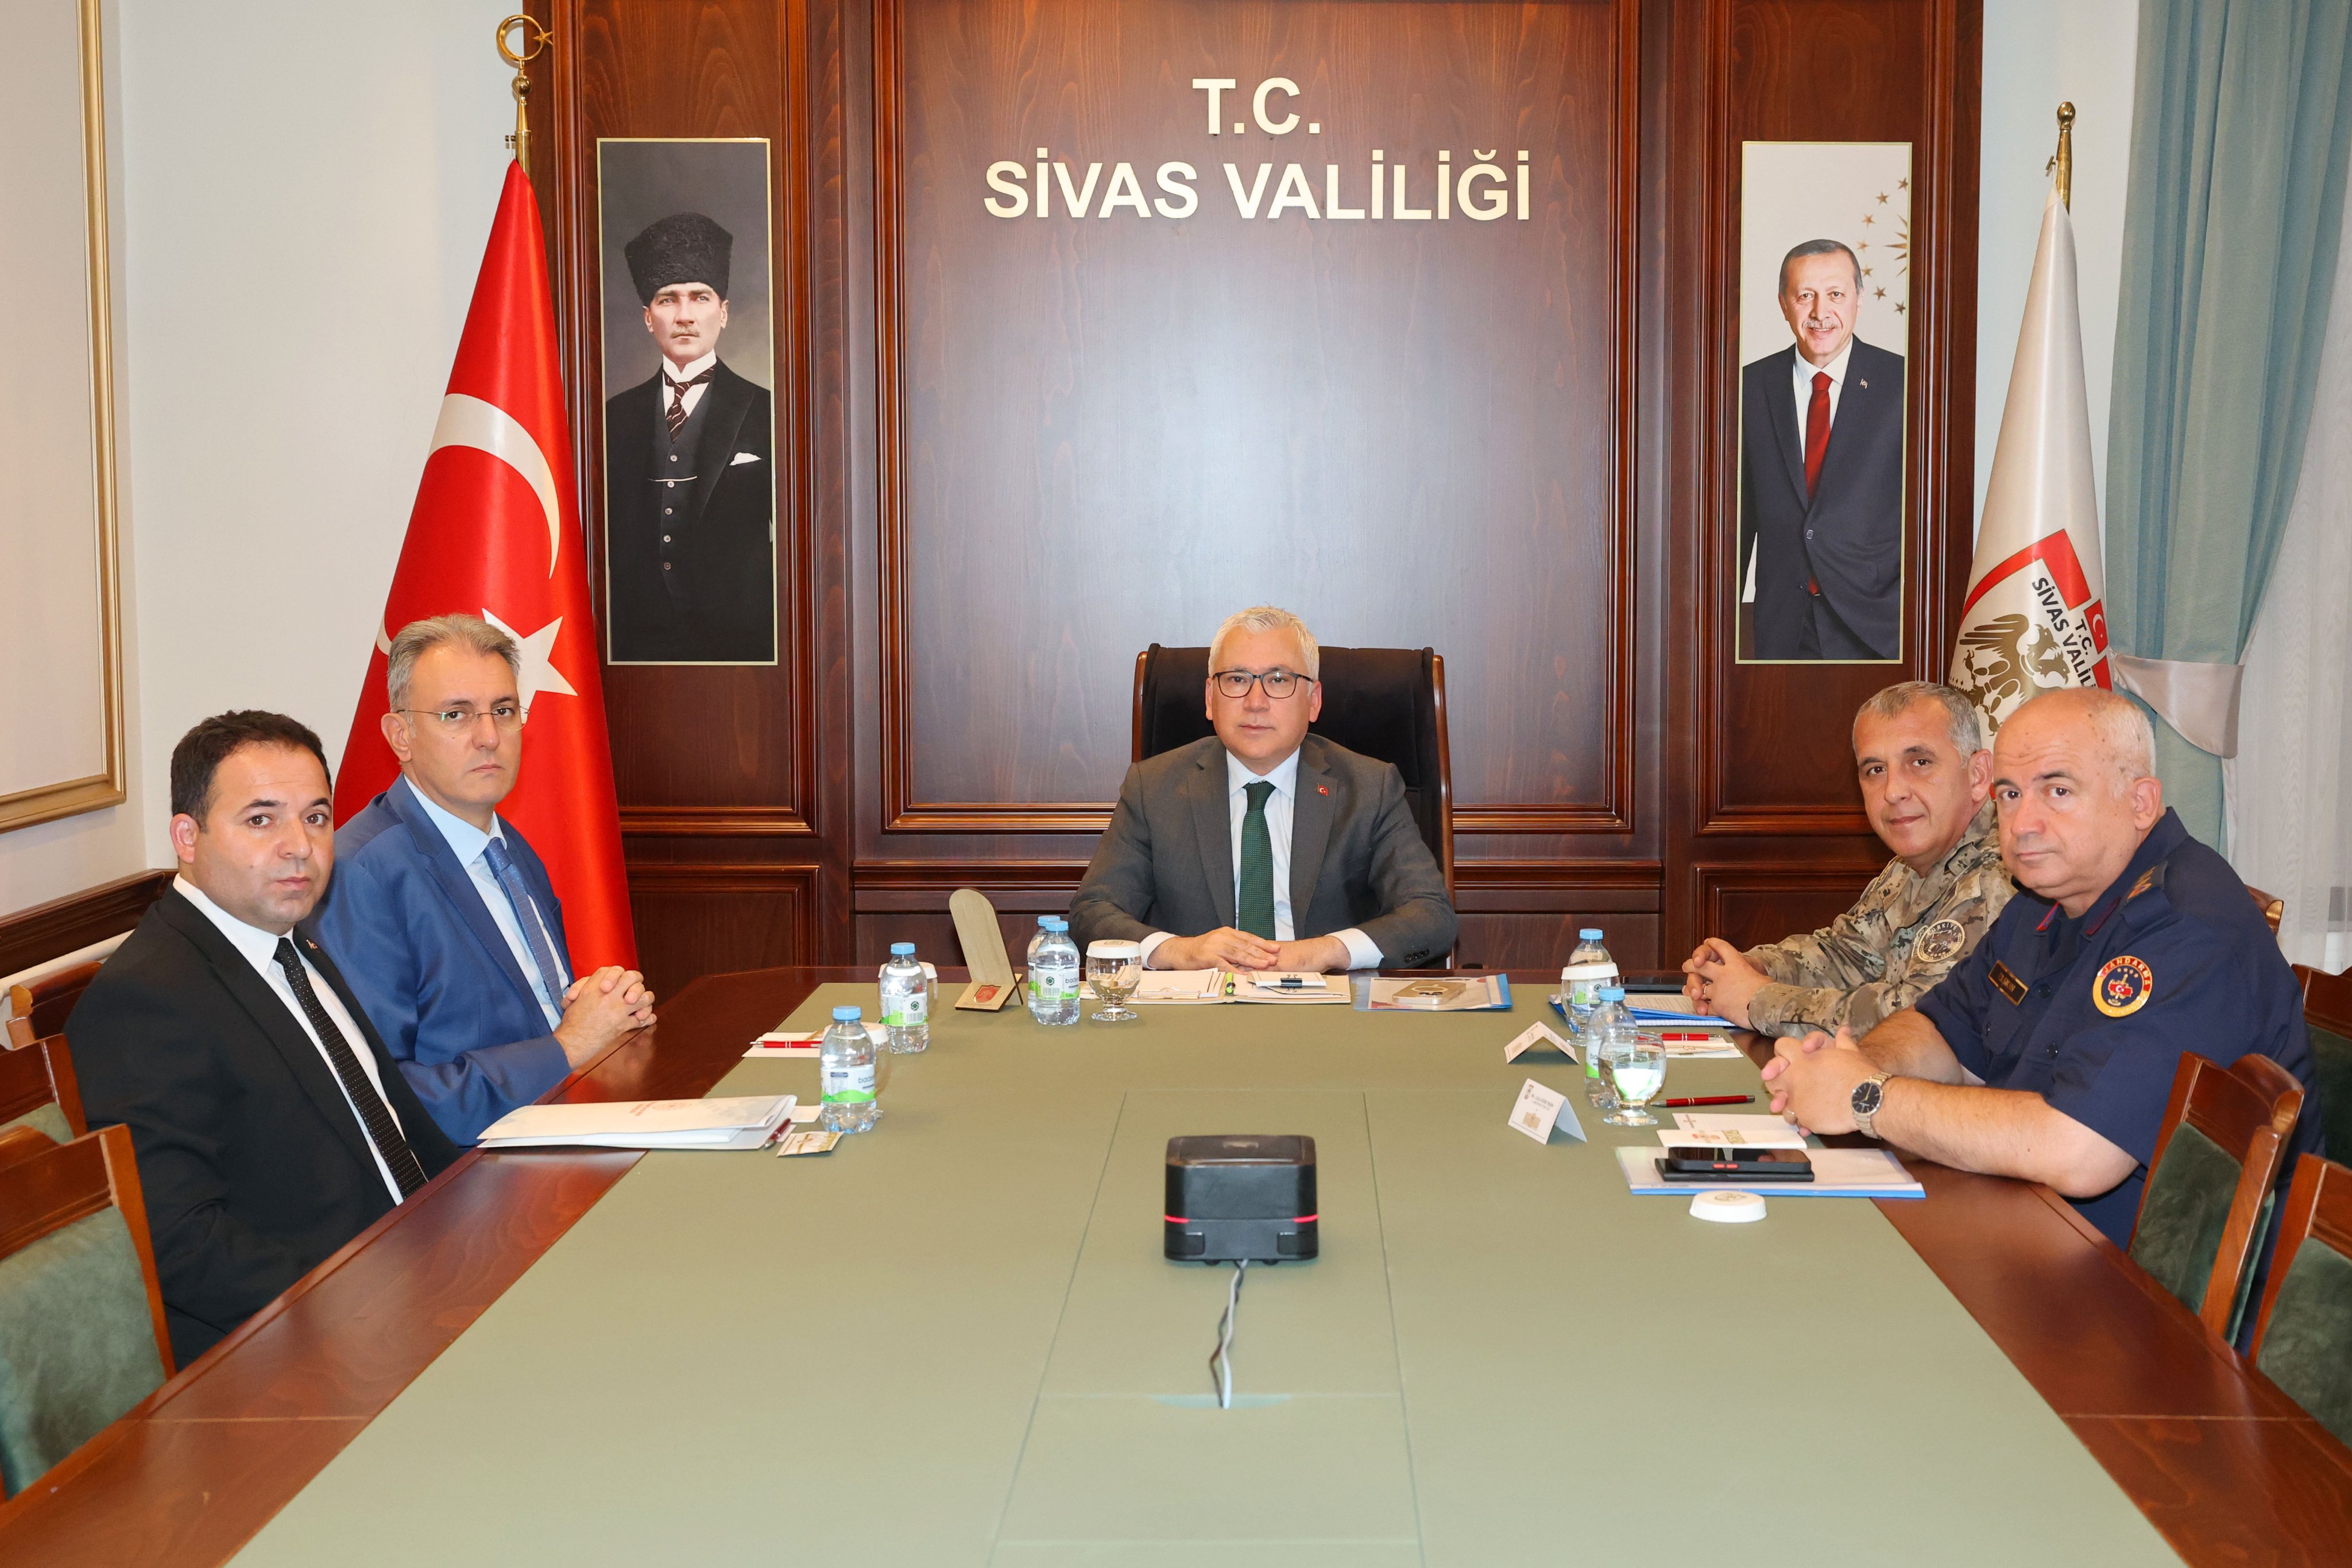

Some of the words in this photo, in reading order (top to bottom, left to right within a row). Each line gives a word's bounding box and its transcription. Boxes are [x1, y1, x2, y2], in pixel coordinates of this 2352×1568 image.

[1192, 77, 1320, 135] T.C.
[984, 147, 1199, 219] SİVAS
[1222, 149, 1529, 222] VALİLİĞİ
[2032, 578, 2070, 632] SİVAS
[2063, 633, 2096, 687] VALİL
[2075, 618, 2092, 656] T.C.
[2104, 957, 2150, 985] JANDARMA
